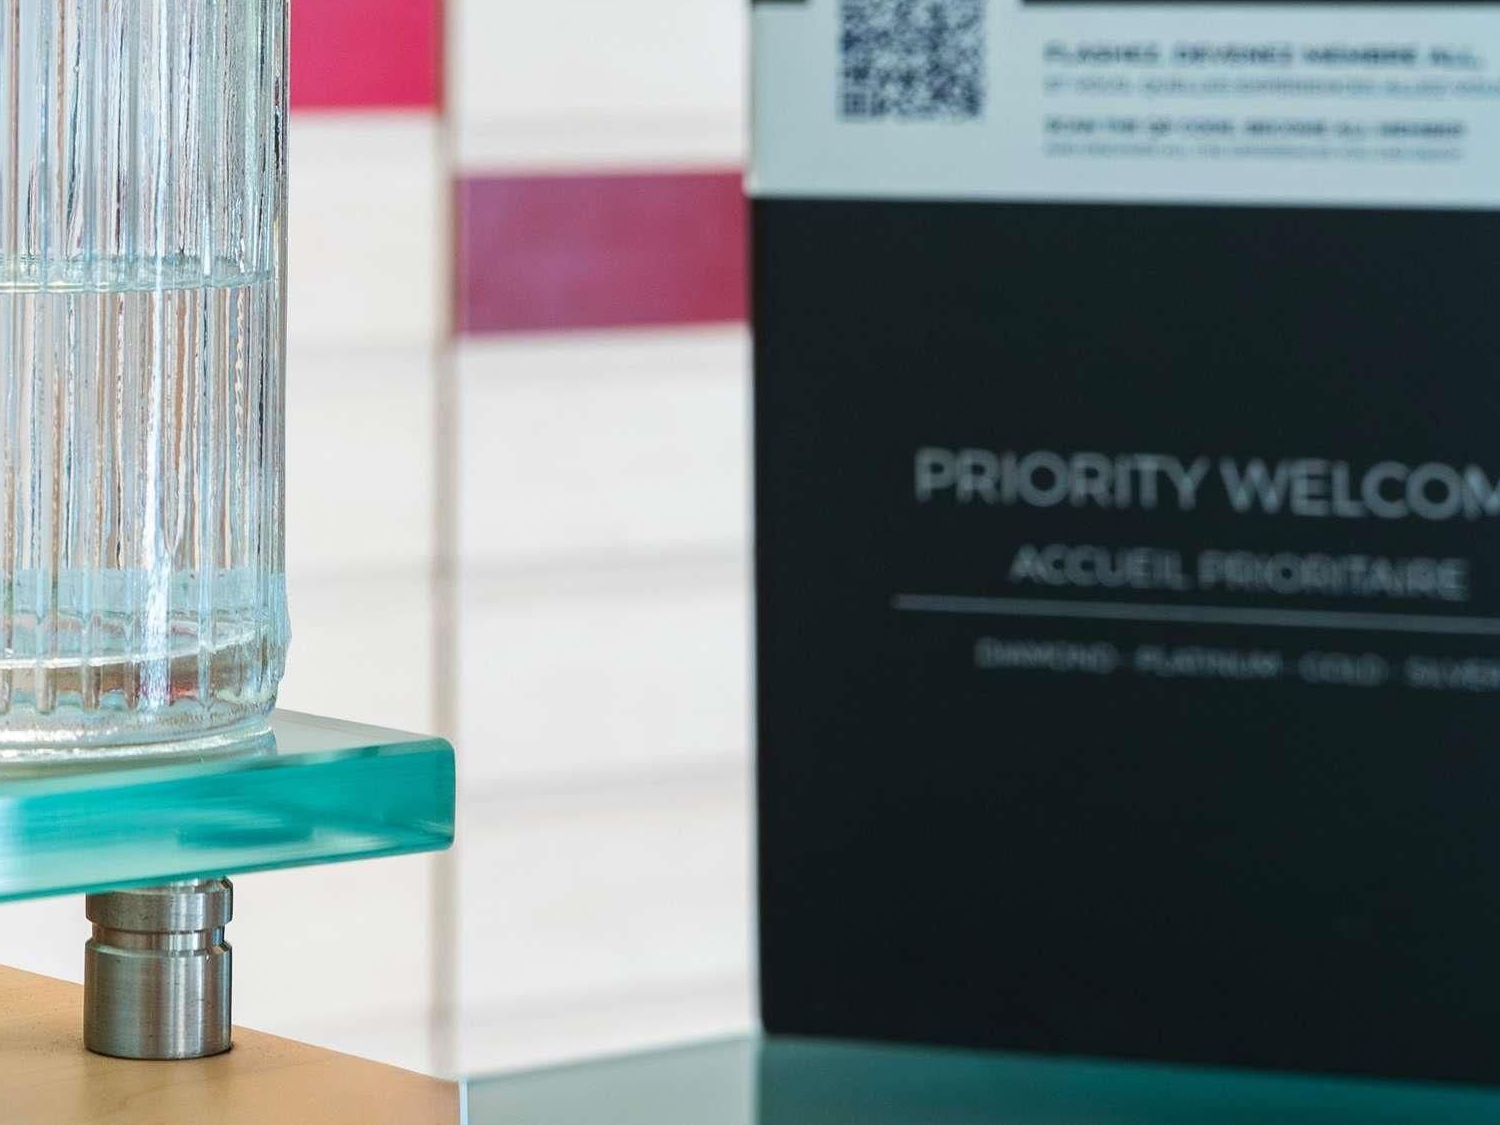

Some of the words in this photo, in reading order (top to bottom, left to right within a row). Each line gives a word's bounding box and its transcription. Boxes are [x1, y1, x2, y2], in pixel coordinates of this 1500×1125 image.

[913, 446, 1211, 512] PRIORITY
[1008, 543, 1192, 591] ACCUEIL
[1197, 549, 1470, 602] PRIORITAIRE
